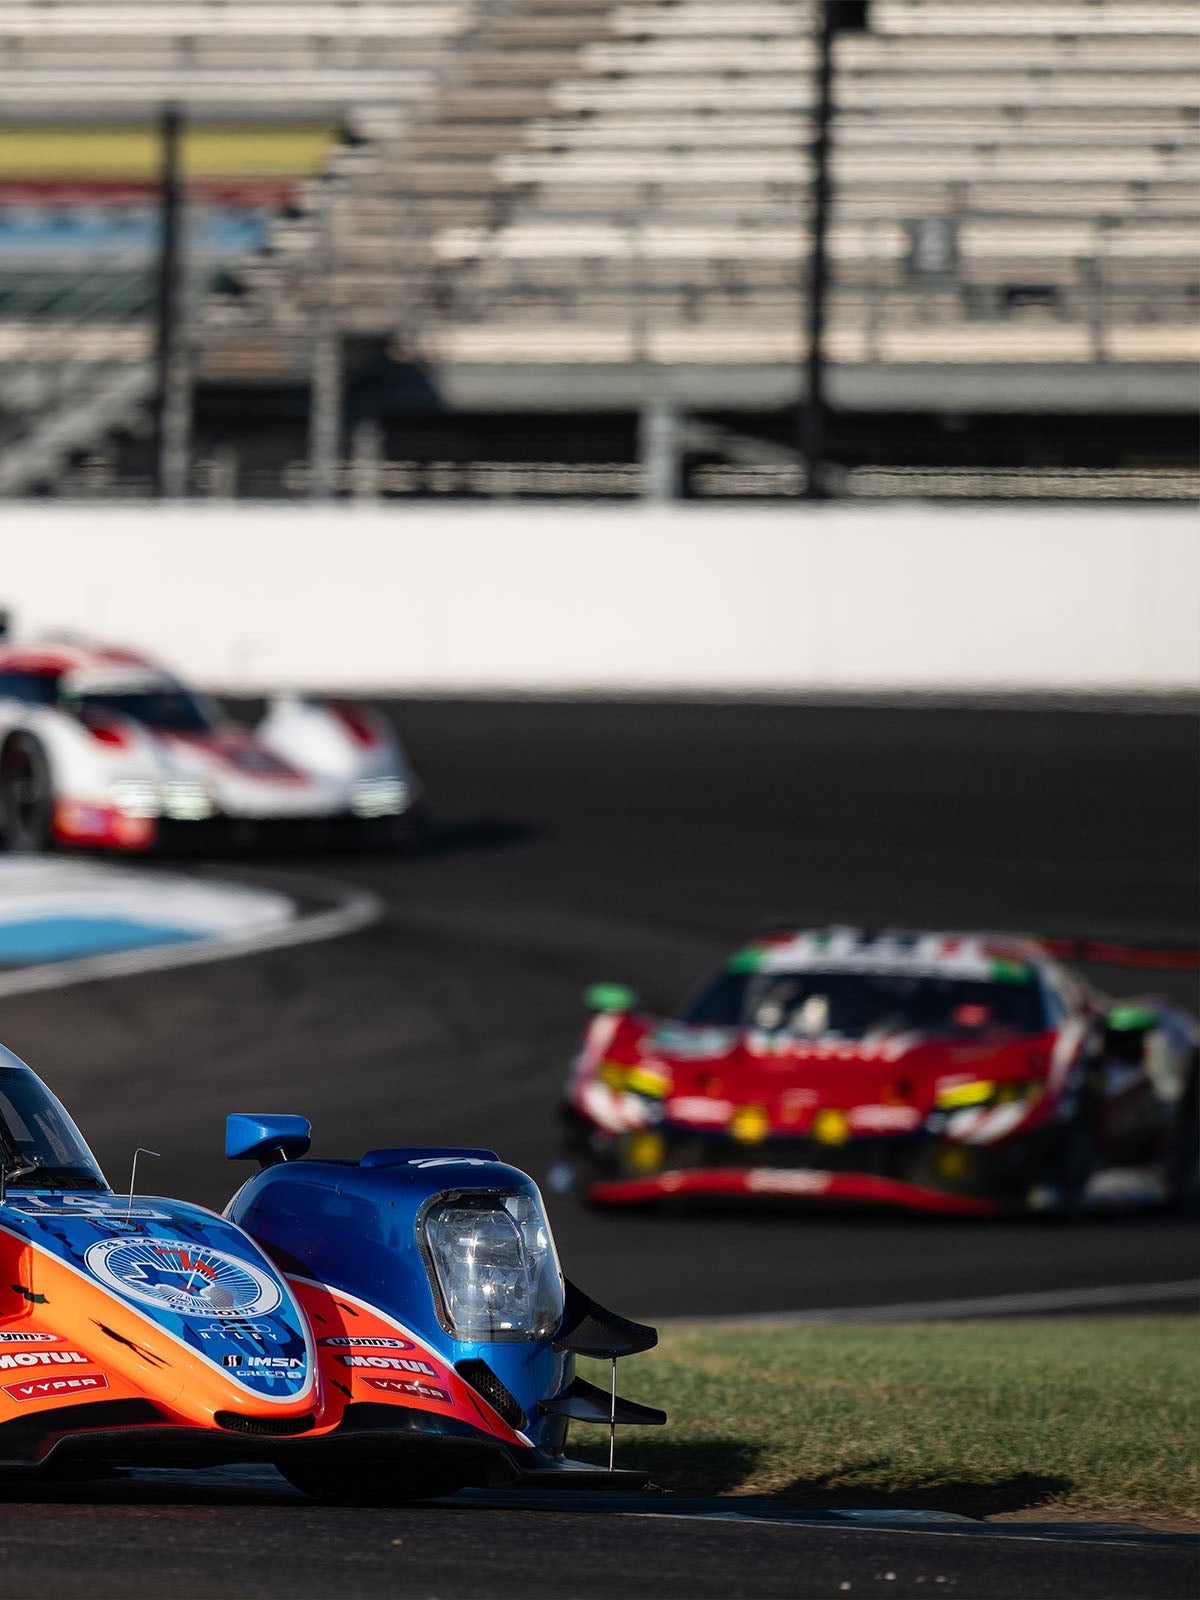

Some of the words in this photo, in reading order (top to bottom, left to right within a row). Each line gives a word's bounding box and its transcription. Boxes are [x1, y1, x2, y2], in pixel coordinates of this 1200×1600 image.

[200, 1332, 278, 1341] RILEY
[344, 1355, 435, 1376] MOTUL
[19, 1379, 98, 1395] VYPER
[374, 1380, 444, 1398] VYPER
